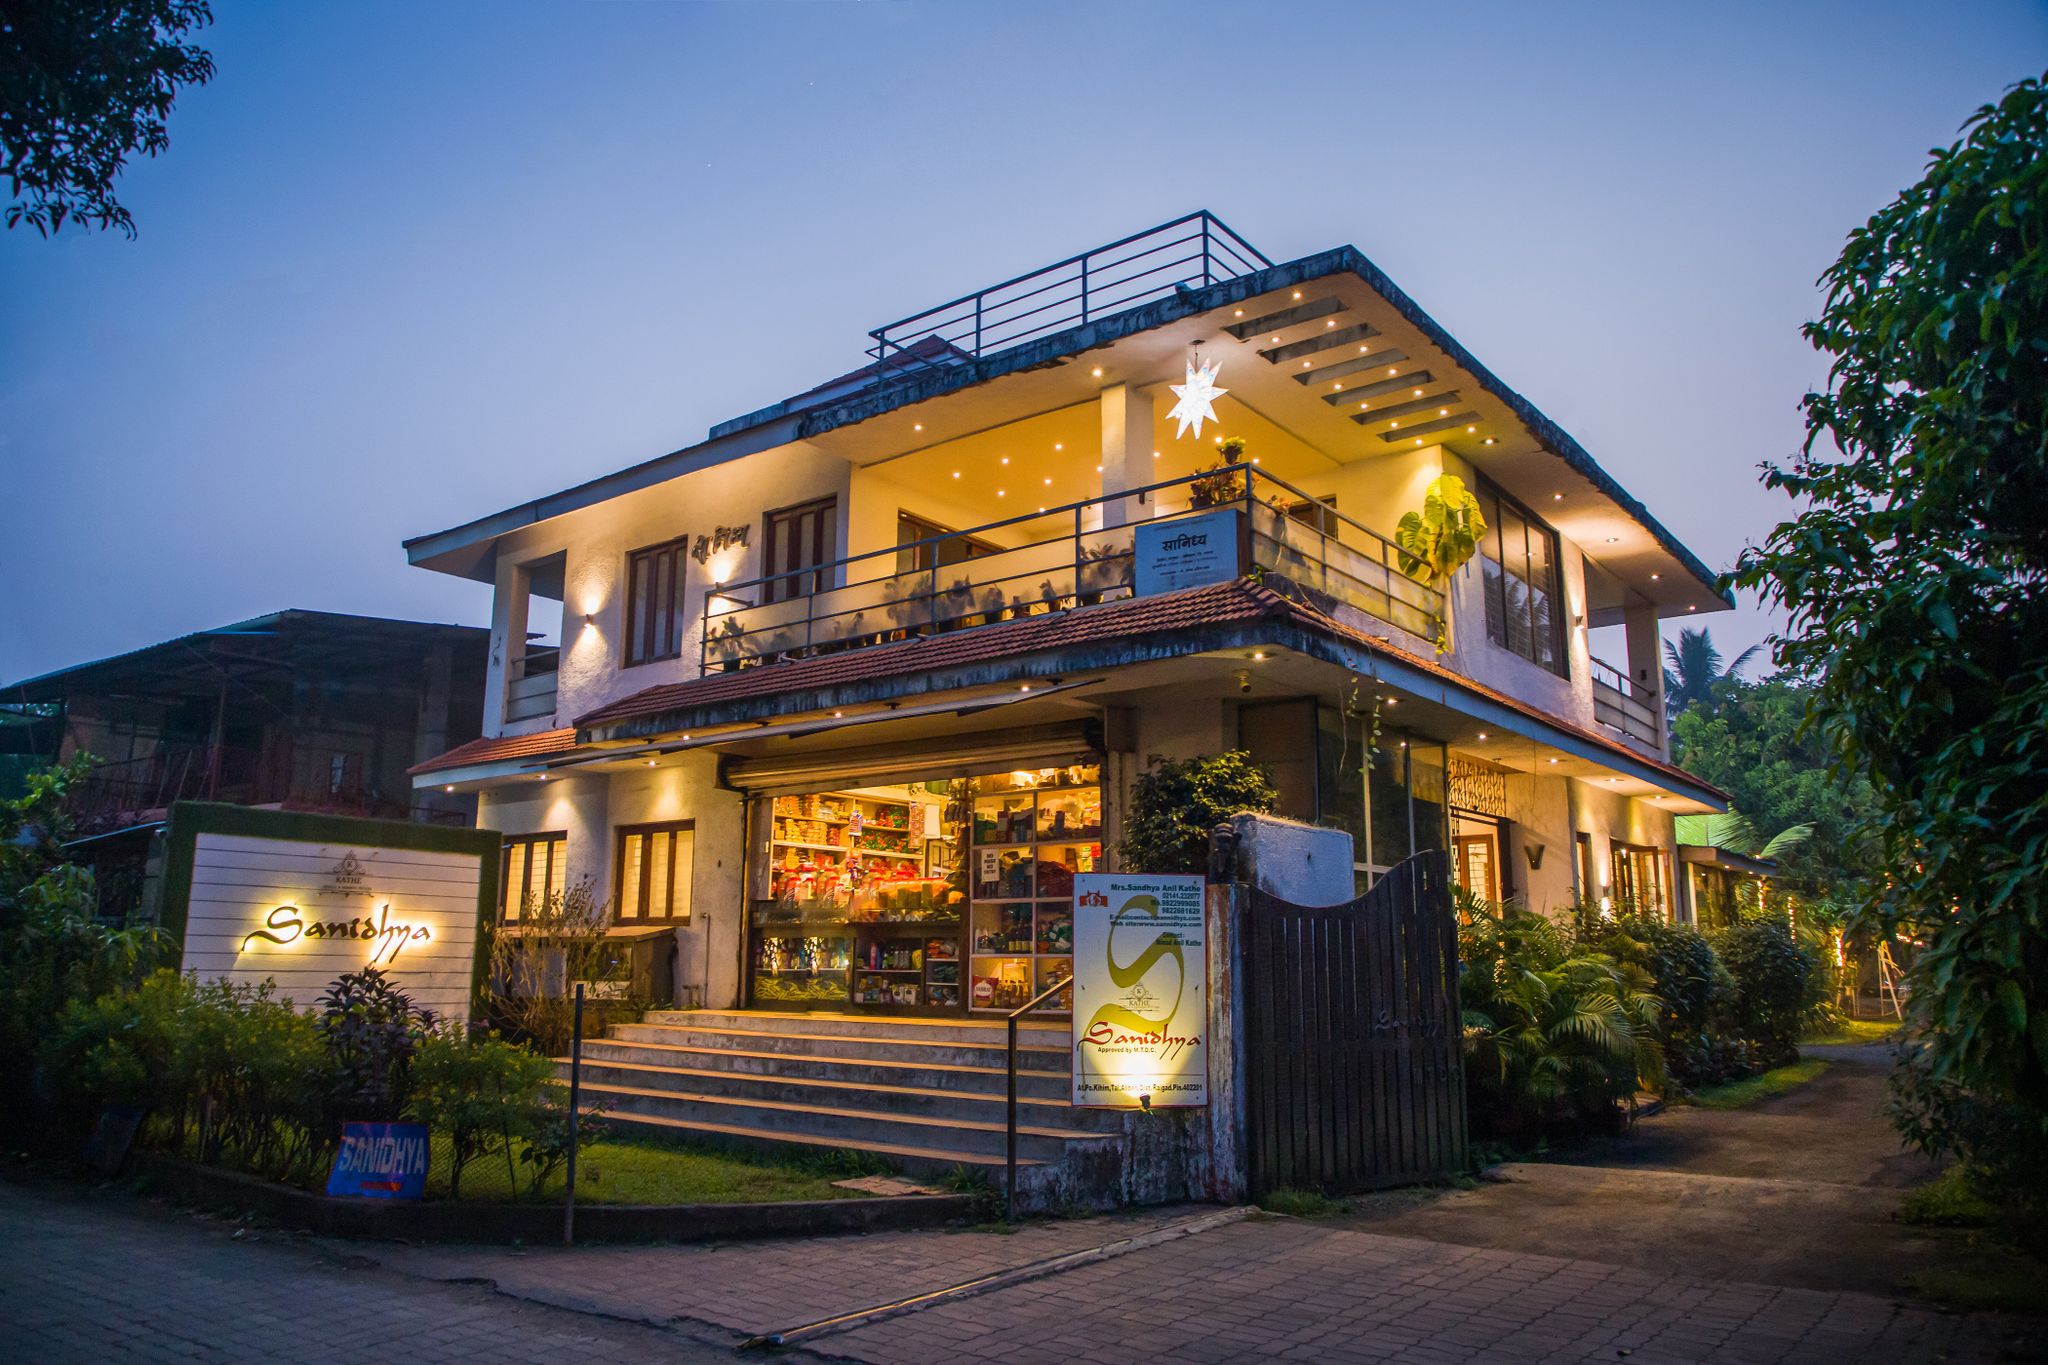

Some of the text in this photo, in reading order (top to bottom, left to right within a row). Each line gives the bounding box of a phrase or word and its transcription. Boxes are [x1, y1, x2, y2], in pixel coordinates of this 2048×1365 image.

[1162, 534, 1208, 551] सानिध्य
[336, 876, 361, 884] KATHE
[1110, 883, 1201, 893] Mrs.Sandhya Anil Kathe
[241, 904, 431, 964] Sanidhya
[1076, 1021, 1201, 1060] Sanidhya
[1125, 1046, 1132, 1054] by
[339, 1136, 425, 1175] SANIDHYA
